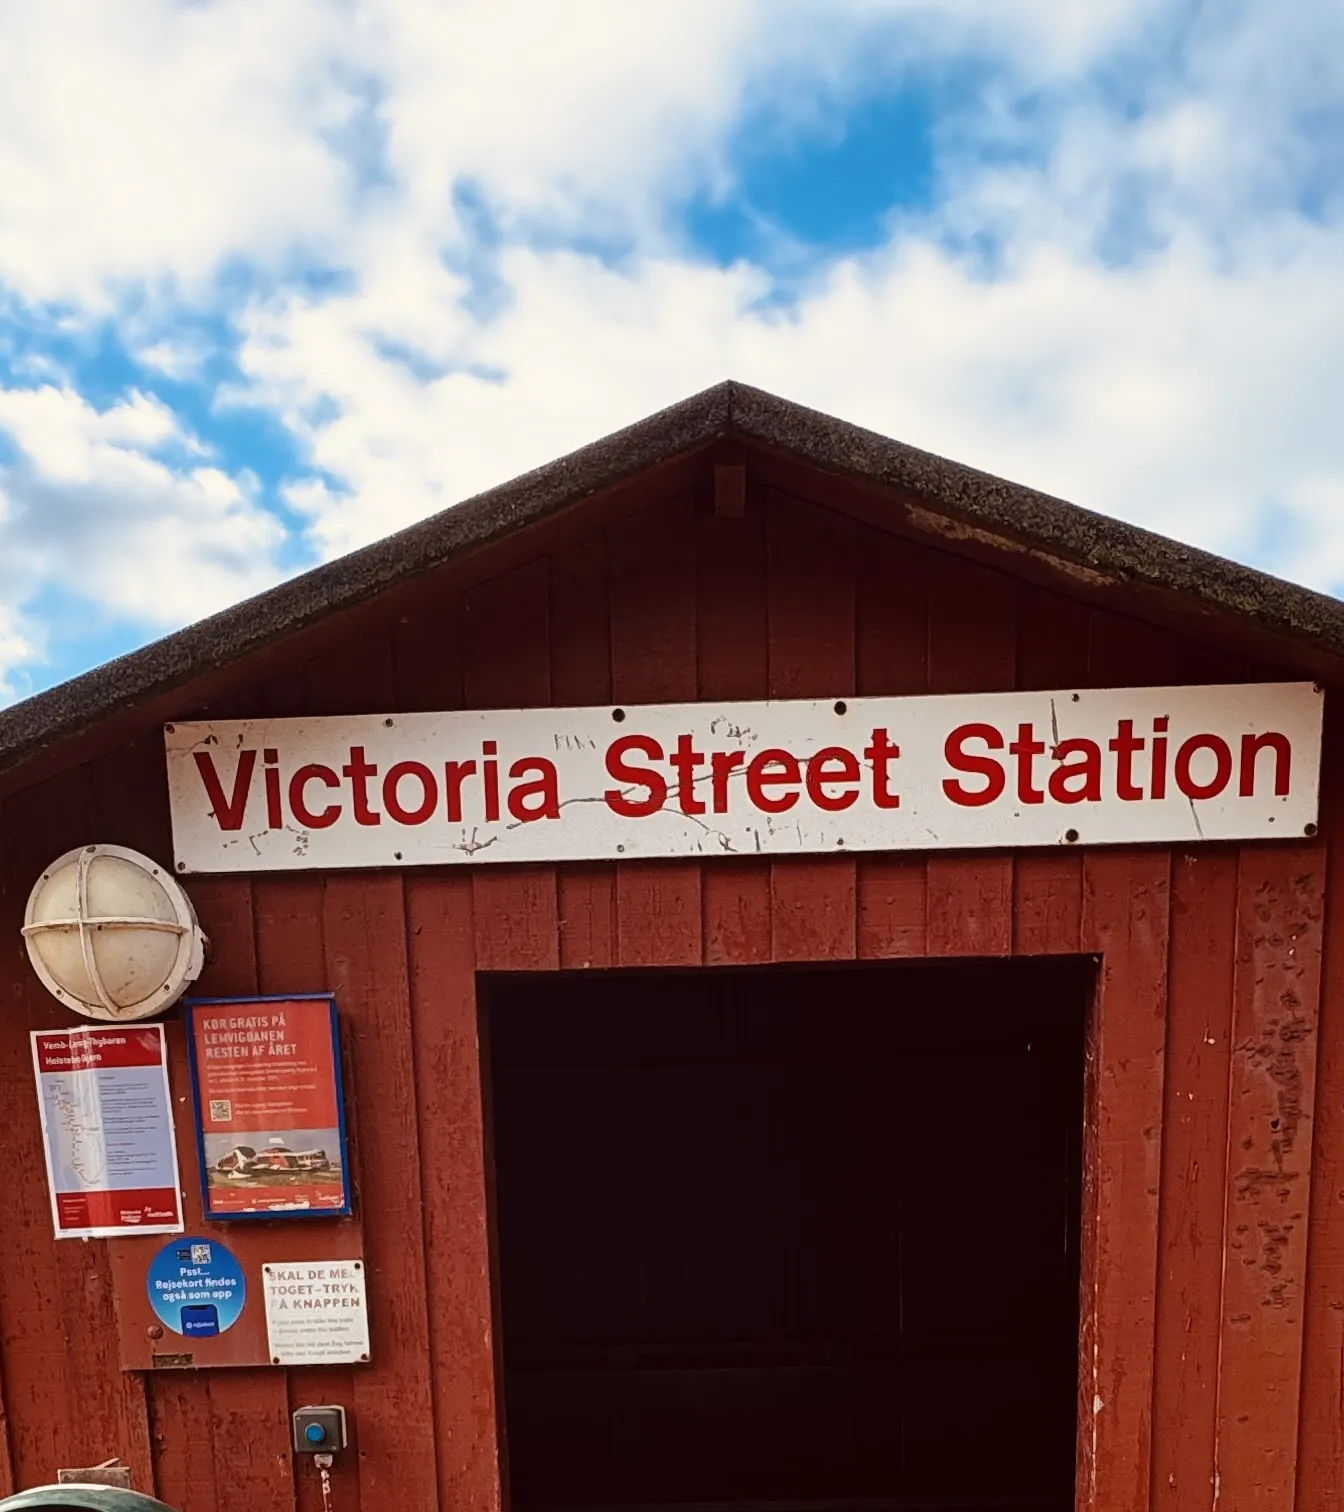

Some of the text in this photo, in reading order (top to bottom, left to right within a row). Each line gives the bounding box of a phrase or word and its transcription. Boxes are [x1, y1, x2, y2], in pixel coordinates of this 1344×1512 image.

[192, 715, 1292, 832] Victoria Street Station
[203, 1011, 286, 1030] KØR GRATIS PÅ
[205, 1041, 297, 1058] RESTEN AF ÅRET
[269, 1270, 304, 1281] SKAL
[308, 1269, 326, 1280] DE
[156, 1276, 237, 1291] Rejsekort findes
[189, 1290, 210, 1298] som
[293, 1297, 360, 1309] KNAPPEN
